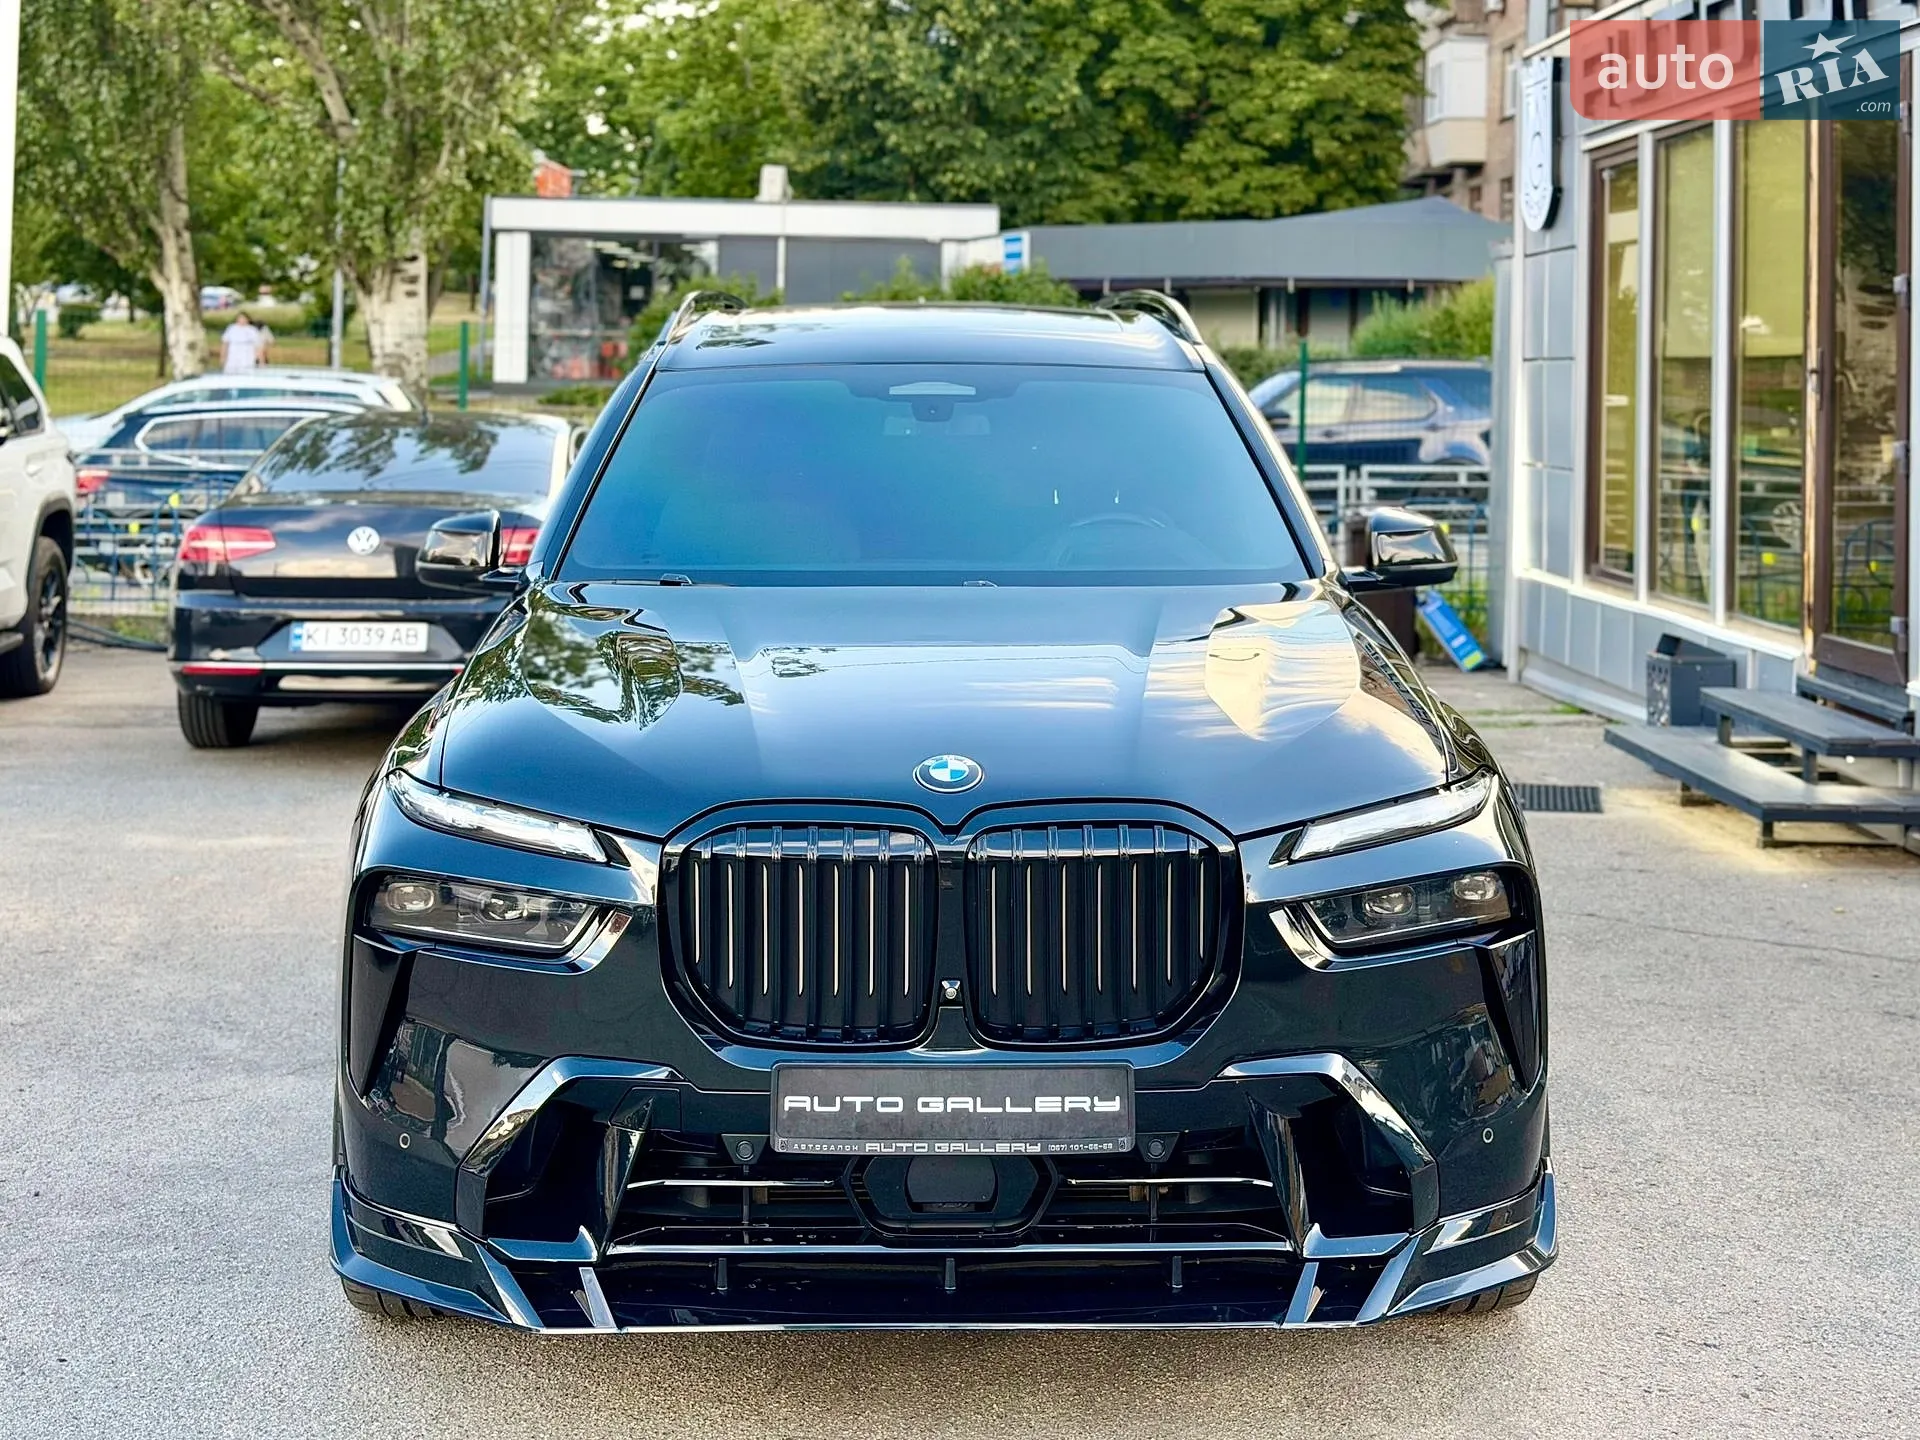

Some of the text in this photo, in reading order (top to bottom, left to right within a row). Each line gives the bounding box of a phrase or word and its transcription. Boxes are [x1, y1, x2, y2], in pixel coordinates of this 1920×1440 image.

[338, 627, 385, 646] 3039
[391, 627, 418, 646] AB
[784, 1096, 1121, 1113] AUTO GALLERY
[865, 1143, 928, 1153] AUTO
[934, 1142, 1041, 1153] GALLERY
